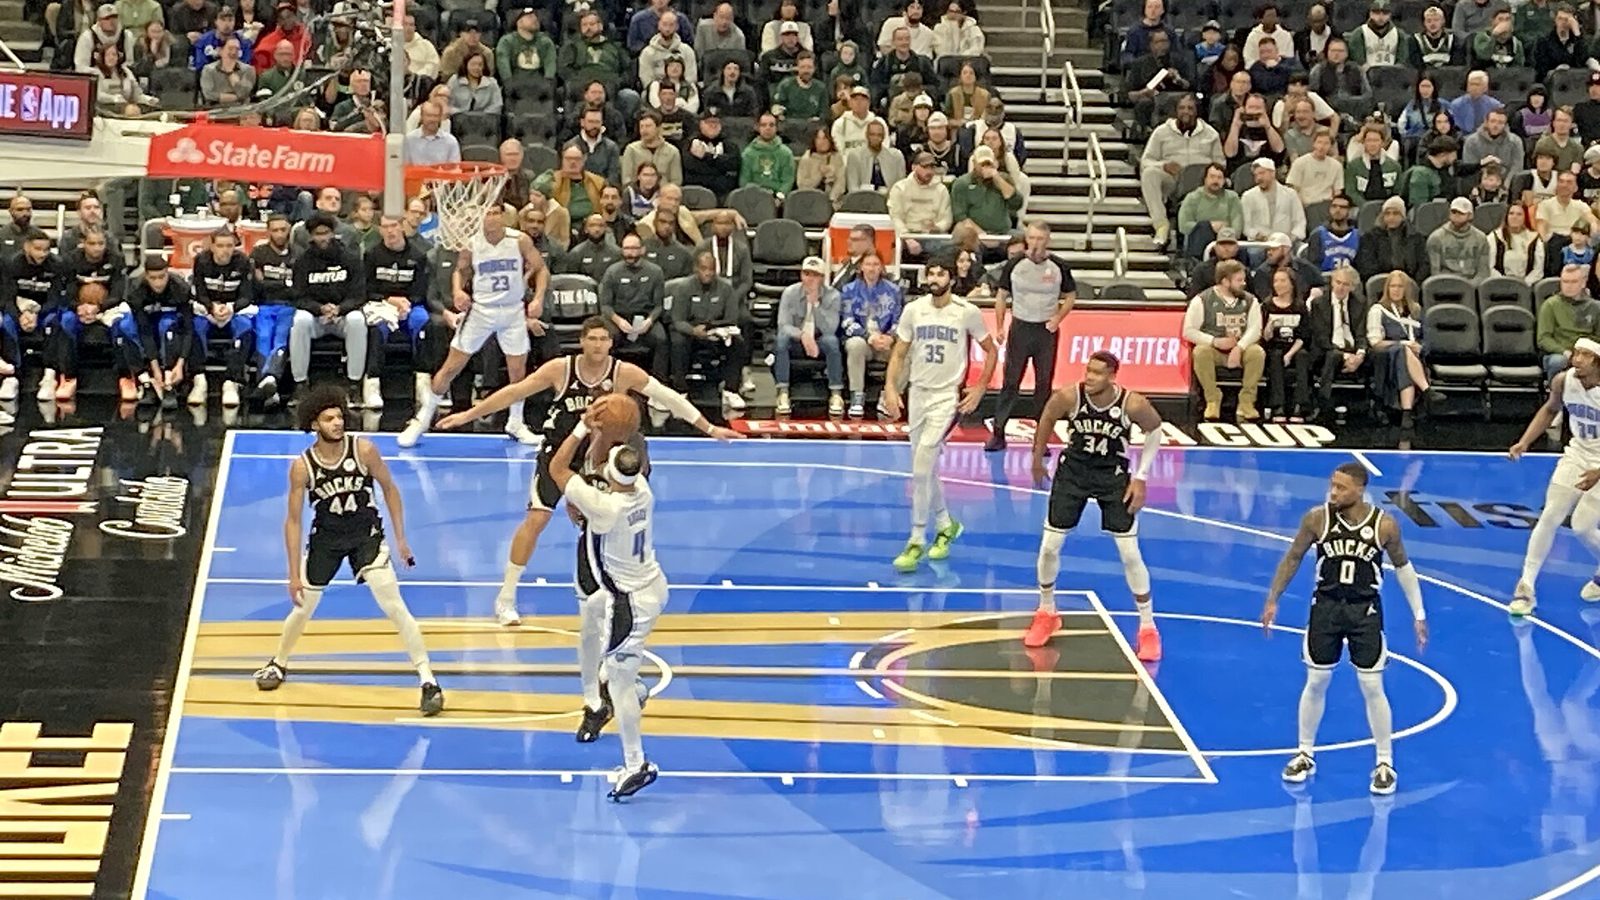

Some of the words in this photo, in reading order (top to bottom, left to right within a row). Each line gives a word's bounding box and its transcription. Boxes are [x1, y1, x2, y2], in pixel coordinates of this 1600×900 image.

[39, 87, 80, 129] App
[490, 275, 510, 292] 23
[915, 325, 958, 345] MAGIC
[924, 344, 945, 364] 35
[1109, 335, 1180, 366] BETTER
[565, 395, 594, 413] BUC
[745, 420, 911, 433] Emirat
[1073, 419, 1123, 440] BUCKS
[1197, 423, 1336, 448] CUP
[1083, 434, 1109, 456] 34
[6, 427, 104, 497] ULTRA
[314, 476, 364, 500] BUCKS
[329, 493, 358, 515] 44
[0, 512, 74, 601] Michelob
[632, 528, 646, 563] 4
[1322, 538, 1379, 562] BUCKS
[1340, 560, 1356, 584] 0
